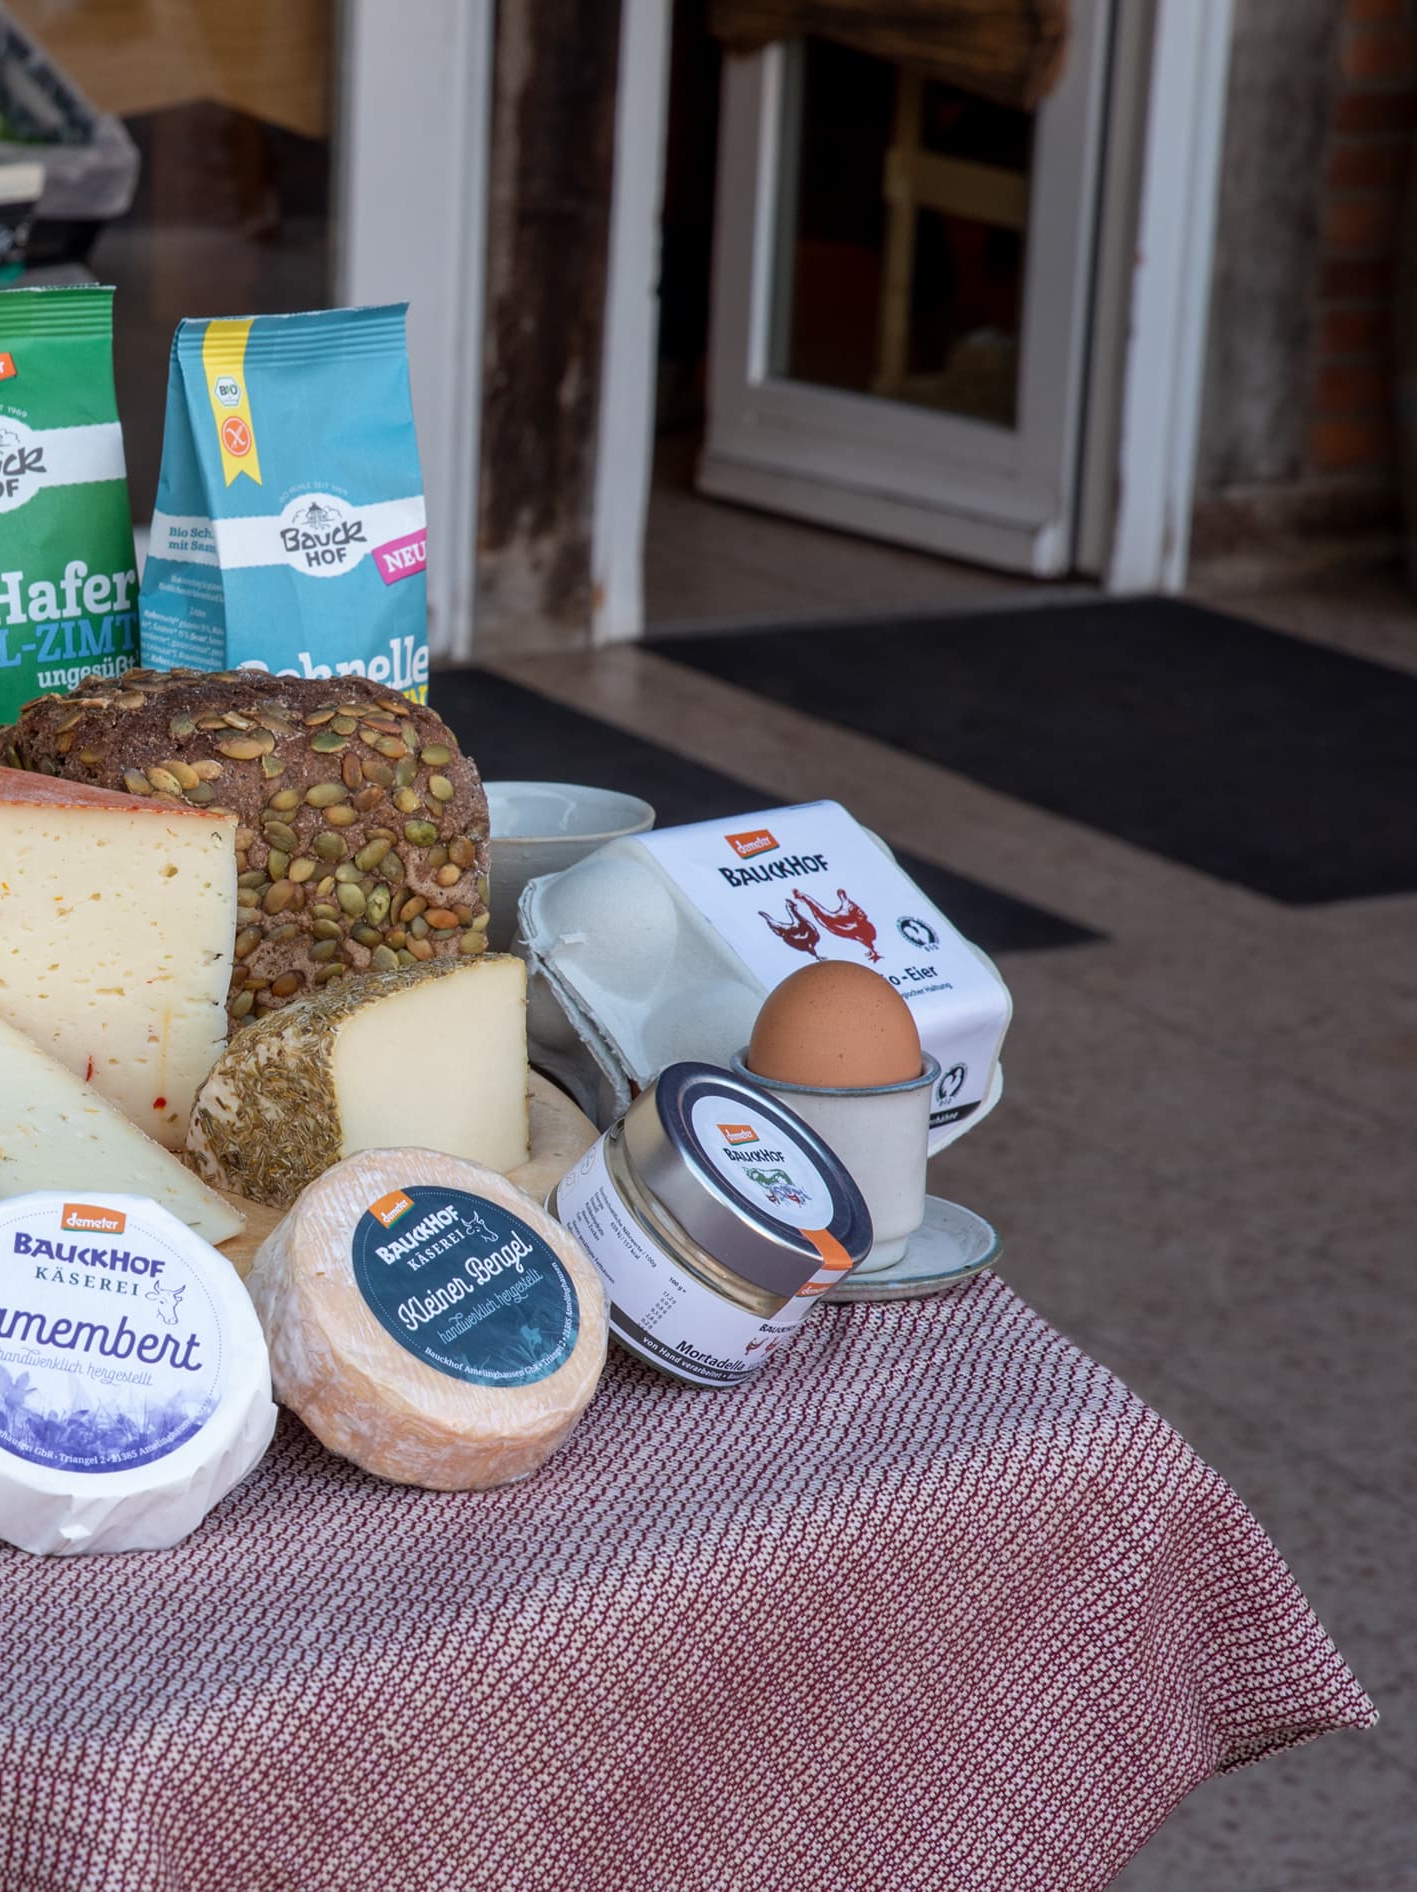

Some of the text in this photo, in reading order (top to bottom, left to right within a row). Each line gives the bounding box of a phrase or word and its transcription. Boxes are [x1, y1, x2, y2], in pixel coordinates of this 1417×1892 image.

[306, 546, 348, 568] HOF
[66, 1212, 119, 1231] demeter
[374, 1204, 461, 1267] BAUCKHOF
[13, 1232, 166, 1278] BAUCKHOF
[406, 1230, 466, 1272] KÄSEREI
[35, 1265, 140, 1297] KÄSEREI
[397, 1230, 534, 1332] Kleiner Bengel
[436, 1298, 502, 1345] handwerklich
[424, 1346, 465, 1372] Bauckhof
[642, 1335, 657, 1350] von
[658, 1345, 680, 1367] Hand
[676, 1340, 746, 1371] Mortadella
[83, 1361, 155, 1388] hergestellt
[58, 1452, 99, 1466] Triangel
